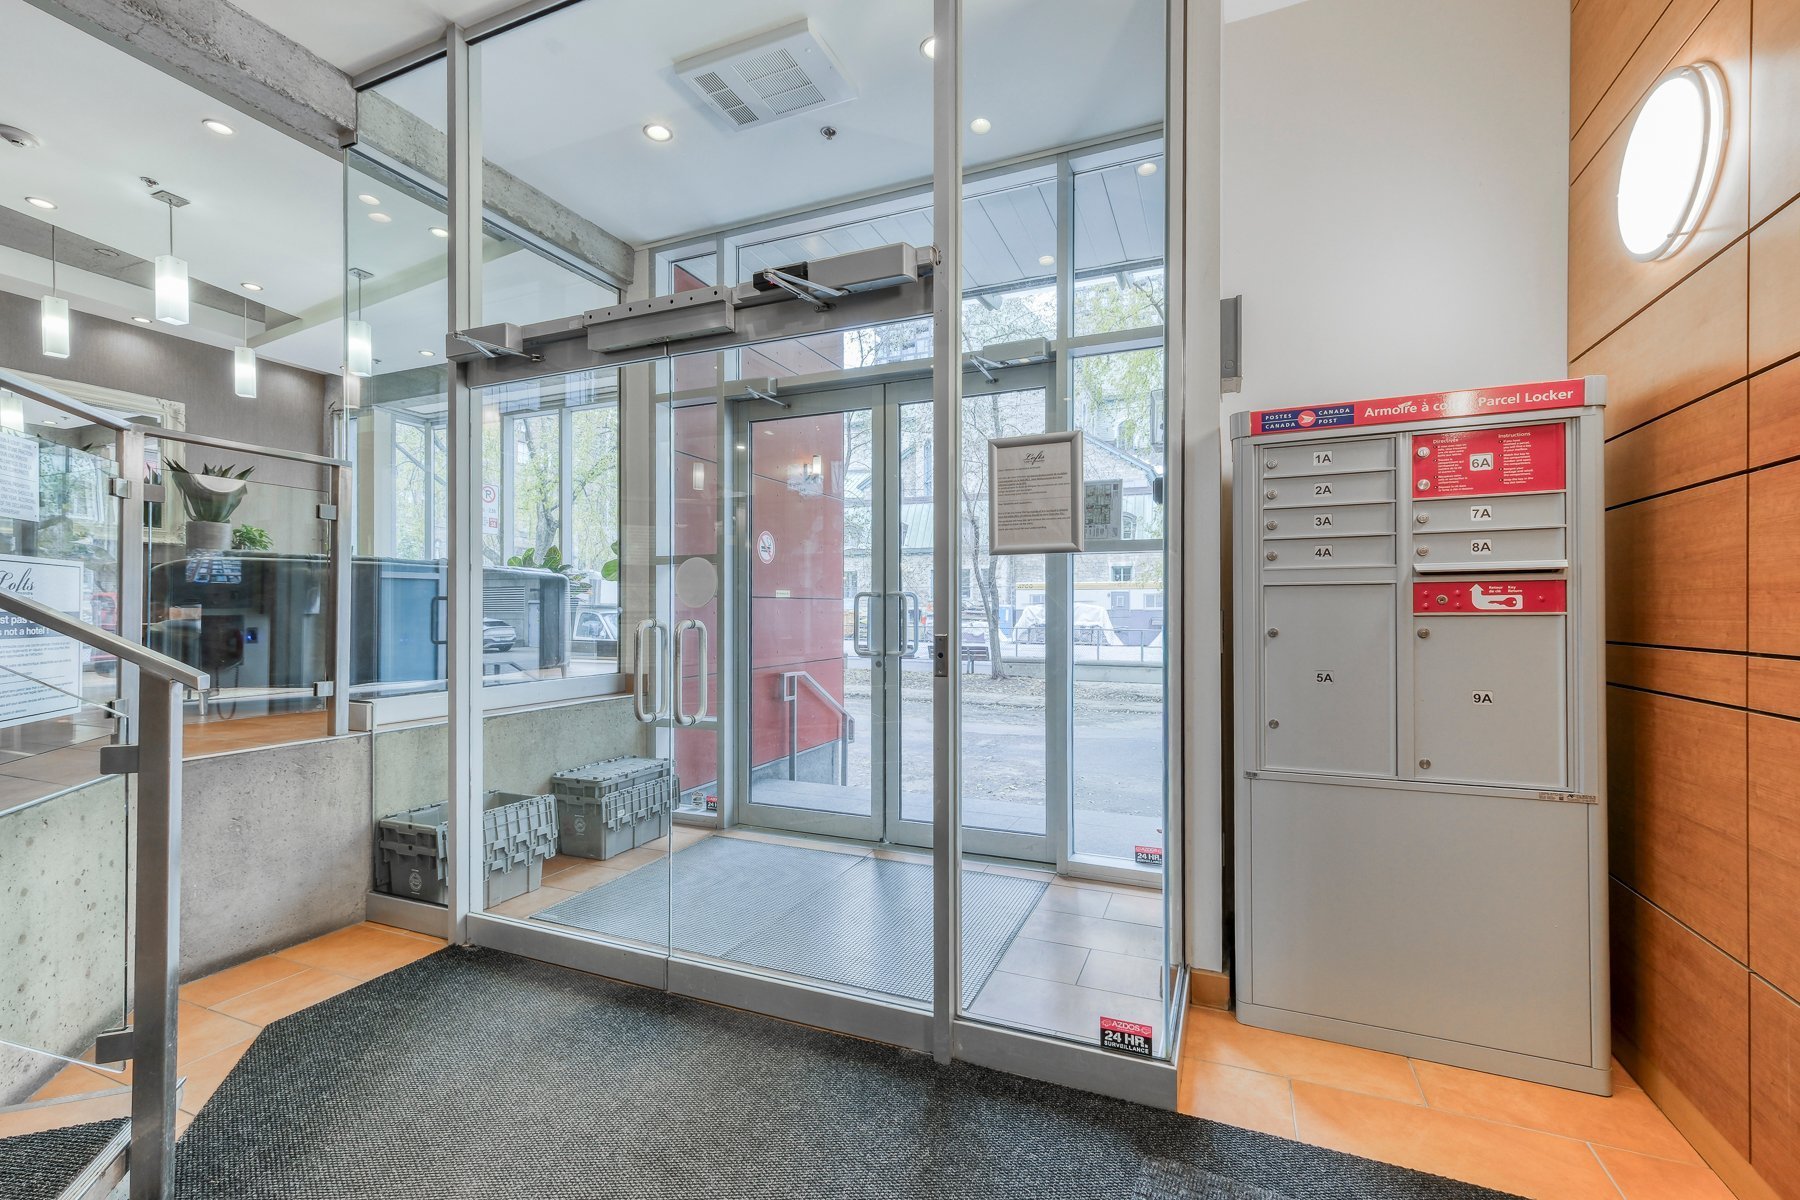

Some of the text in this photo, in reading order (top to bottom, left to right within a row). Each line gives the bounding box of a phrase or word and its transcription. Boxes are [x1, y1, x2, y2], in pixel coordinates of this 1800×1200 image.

[1421, 401, 1429, 412] à
[1478, 392, 1520, 407] Parcel
[1525, 389, 1574, 403] Locker
[1318, 407, 1351, 416] CANADA
[1265, 413, 1292, 421] POSTES
[1265, 421, 1296, 430] CANADA
[1315, 454, 1332, 464] 1A
[1472, 457, 1491, 469] 6A
[1315, 485, 1332, 495] 2A
[1472, 508, 1491, 519] 7A
[1315, 516, 1332, 527] 3A
[1472, 542, 1491, 552] 8A
[1315, 548, 1332, 558] 4A
[4, 627, 17, 636] not
[26, 626, 45, 635] hotel
[1316, 673, 1333, 683] 5A
[1473, 693, 1493, 703] 9A
[1137, 852, 1147, 860] 24
[1104, 1030, 1149, 1049] 24 HR.
[1103, 1040, 1150, 1055] SURVEILLANCE
